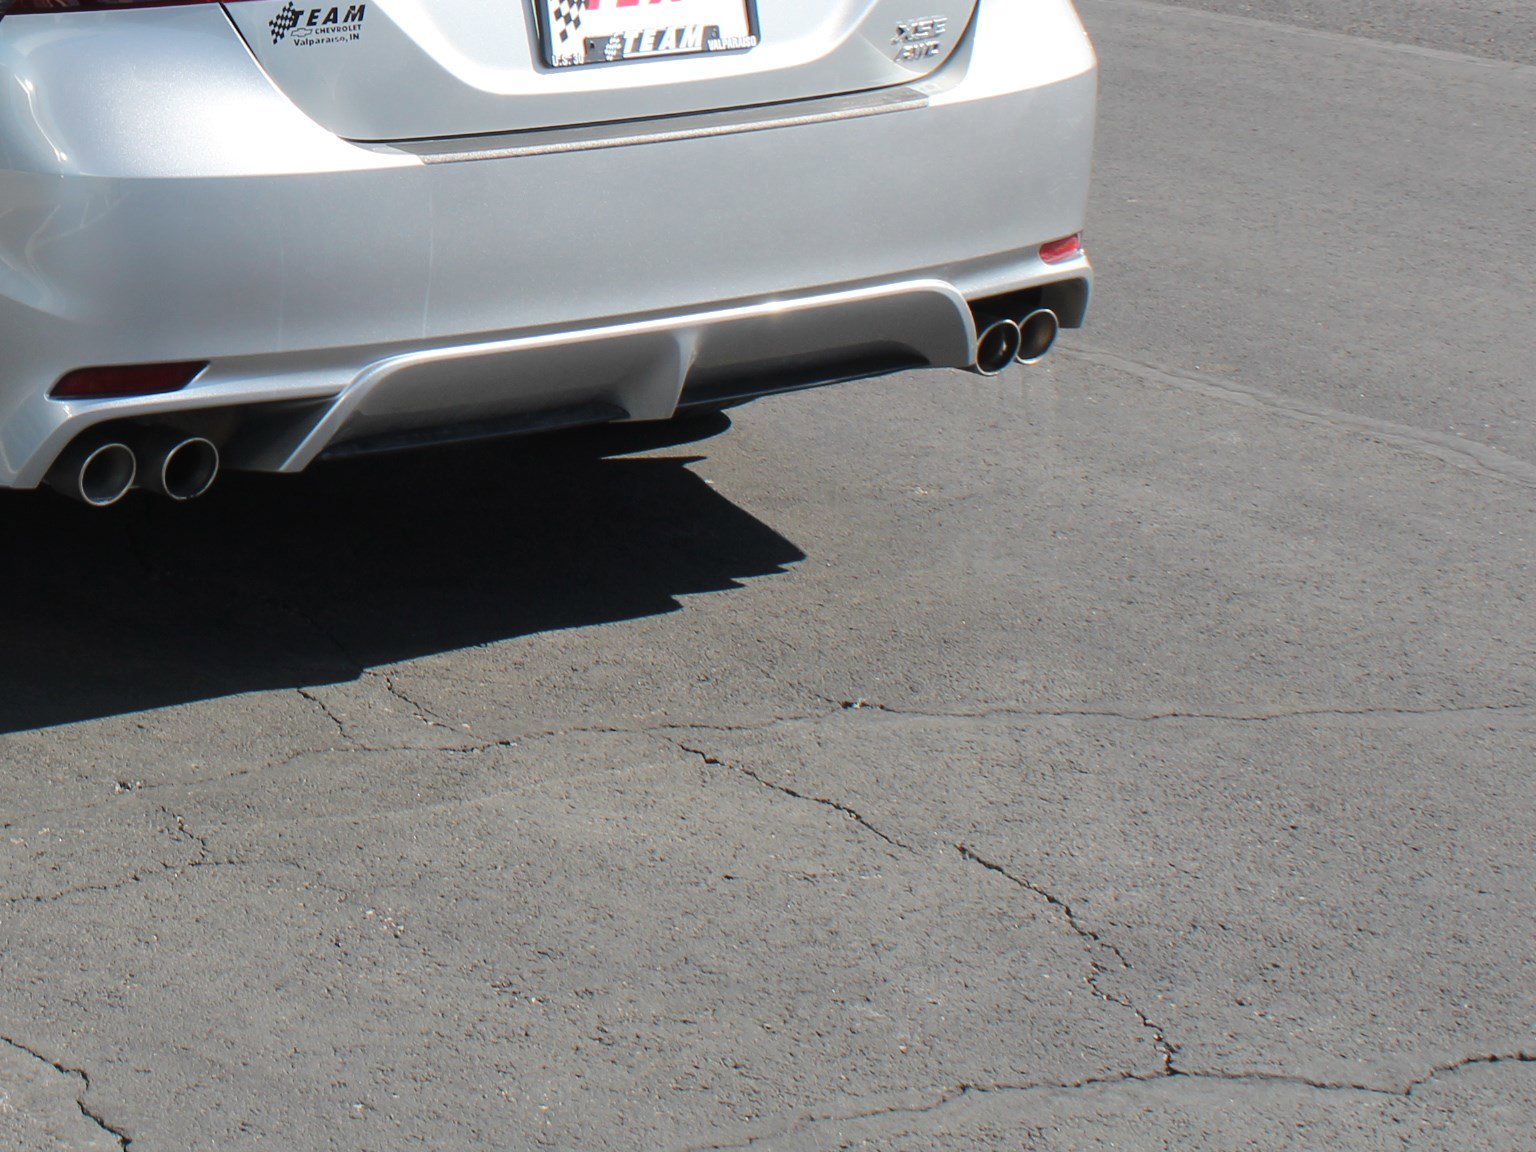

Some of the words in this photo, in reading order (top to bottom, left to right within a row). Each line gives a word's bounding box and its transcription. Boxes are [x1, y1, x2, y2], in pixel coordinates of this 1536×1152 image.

[290, 4, 366, 29] TEAM
[315, 23, 362, 35] CHEVROLET
[349, 32, 360, 41] IN
[623, 23, 705, 55] TEAM
[707, 34, 757, 51] VALPARAISO
